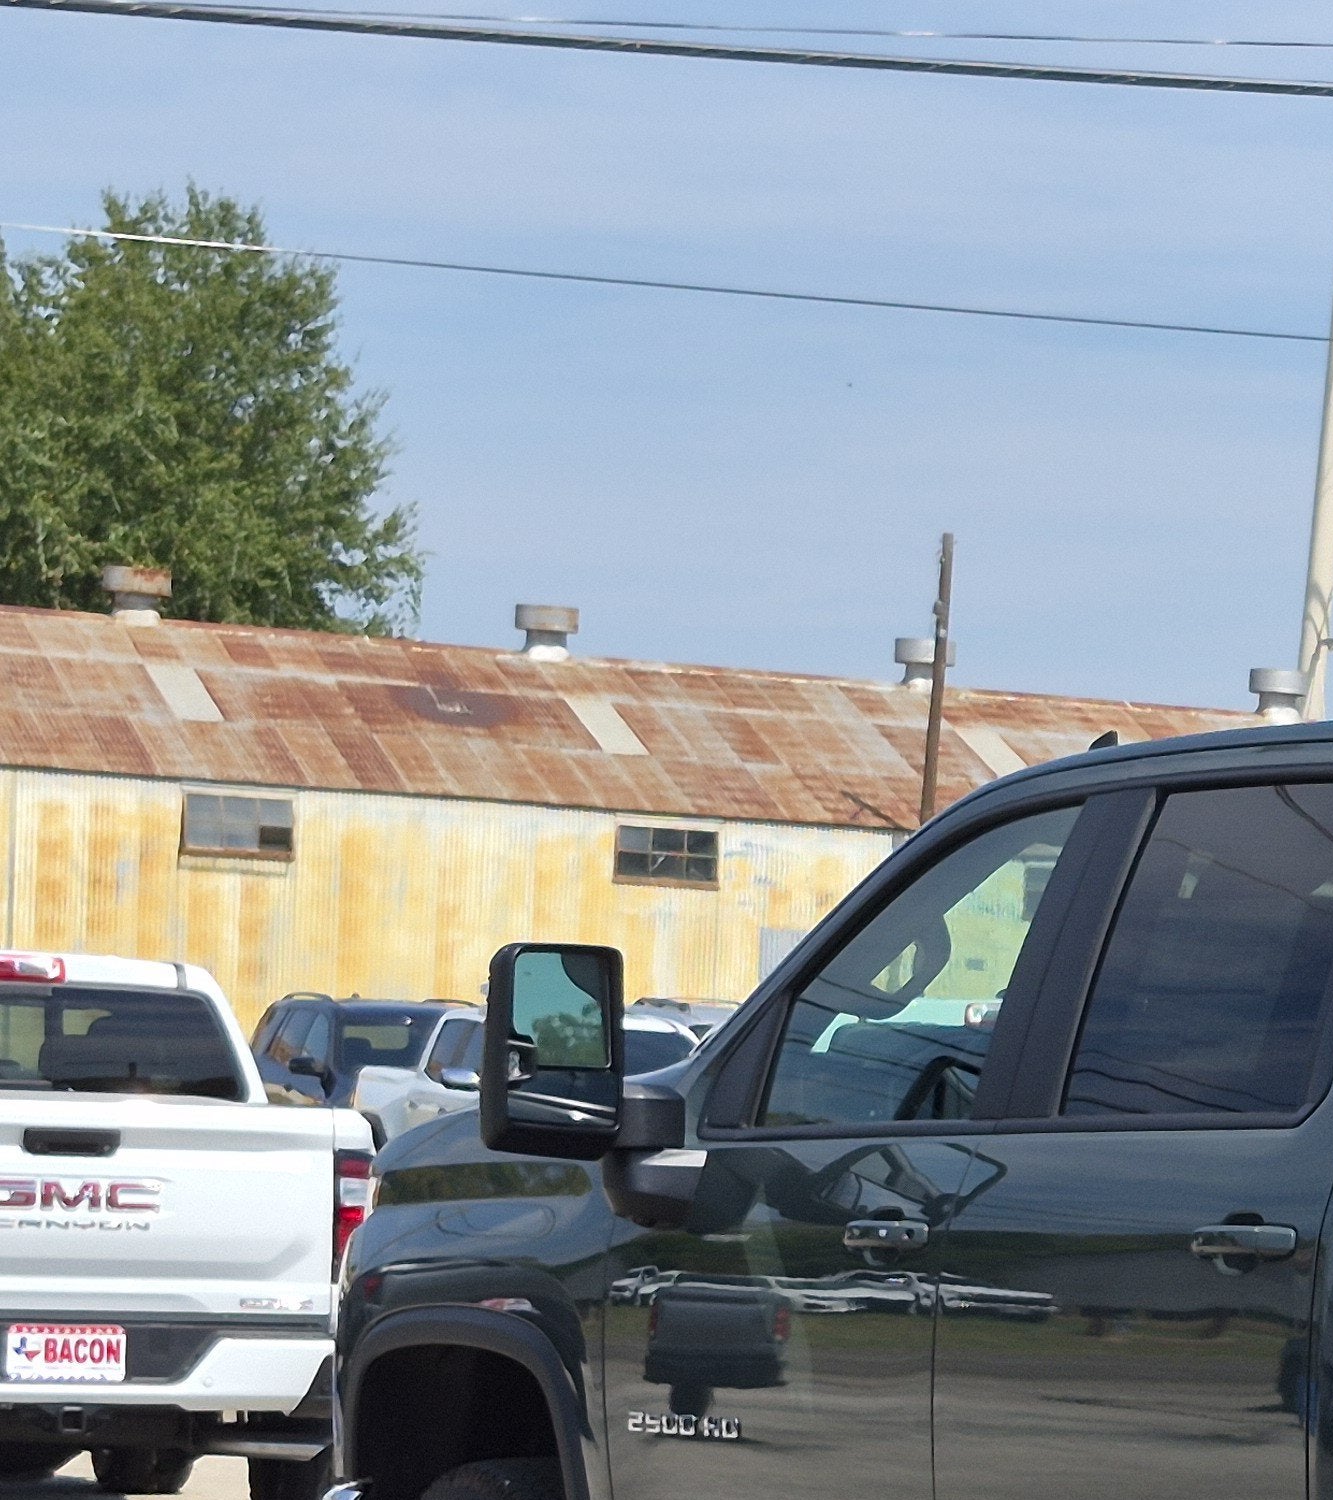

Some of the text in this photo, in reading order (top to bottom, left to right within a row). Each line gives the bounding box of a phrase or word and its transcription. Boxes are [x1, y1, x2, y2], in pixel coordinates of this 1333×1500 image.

[0, 1179, 161, 1213] GMC
[44, 1338, 122, 1364] BACON
[627, 1411, 741, 1438] 2500 HD
